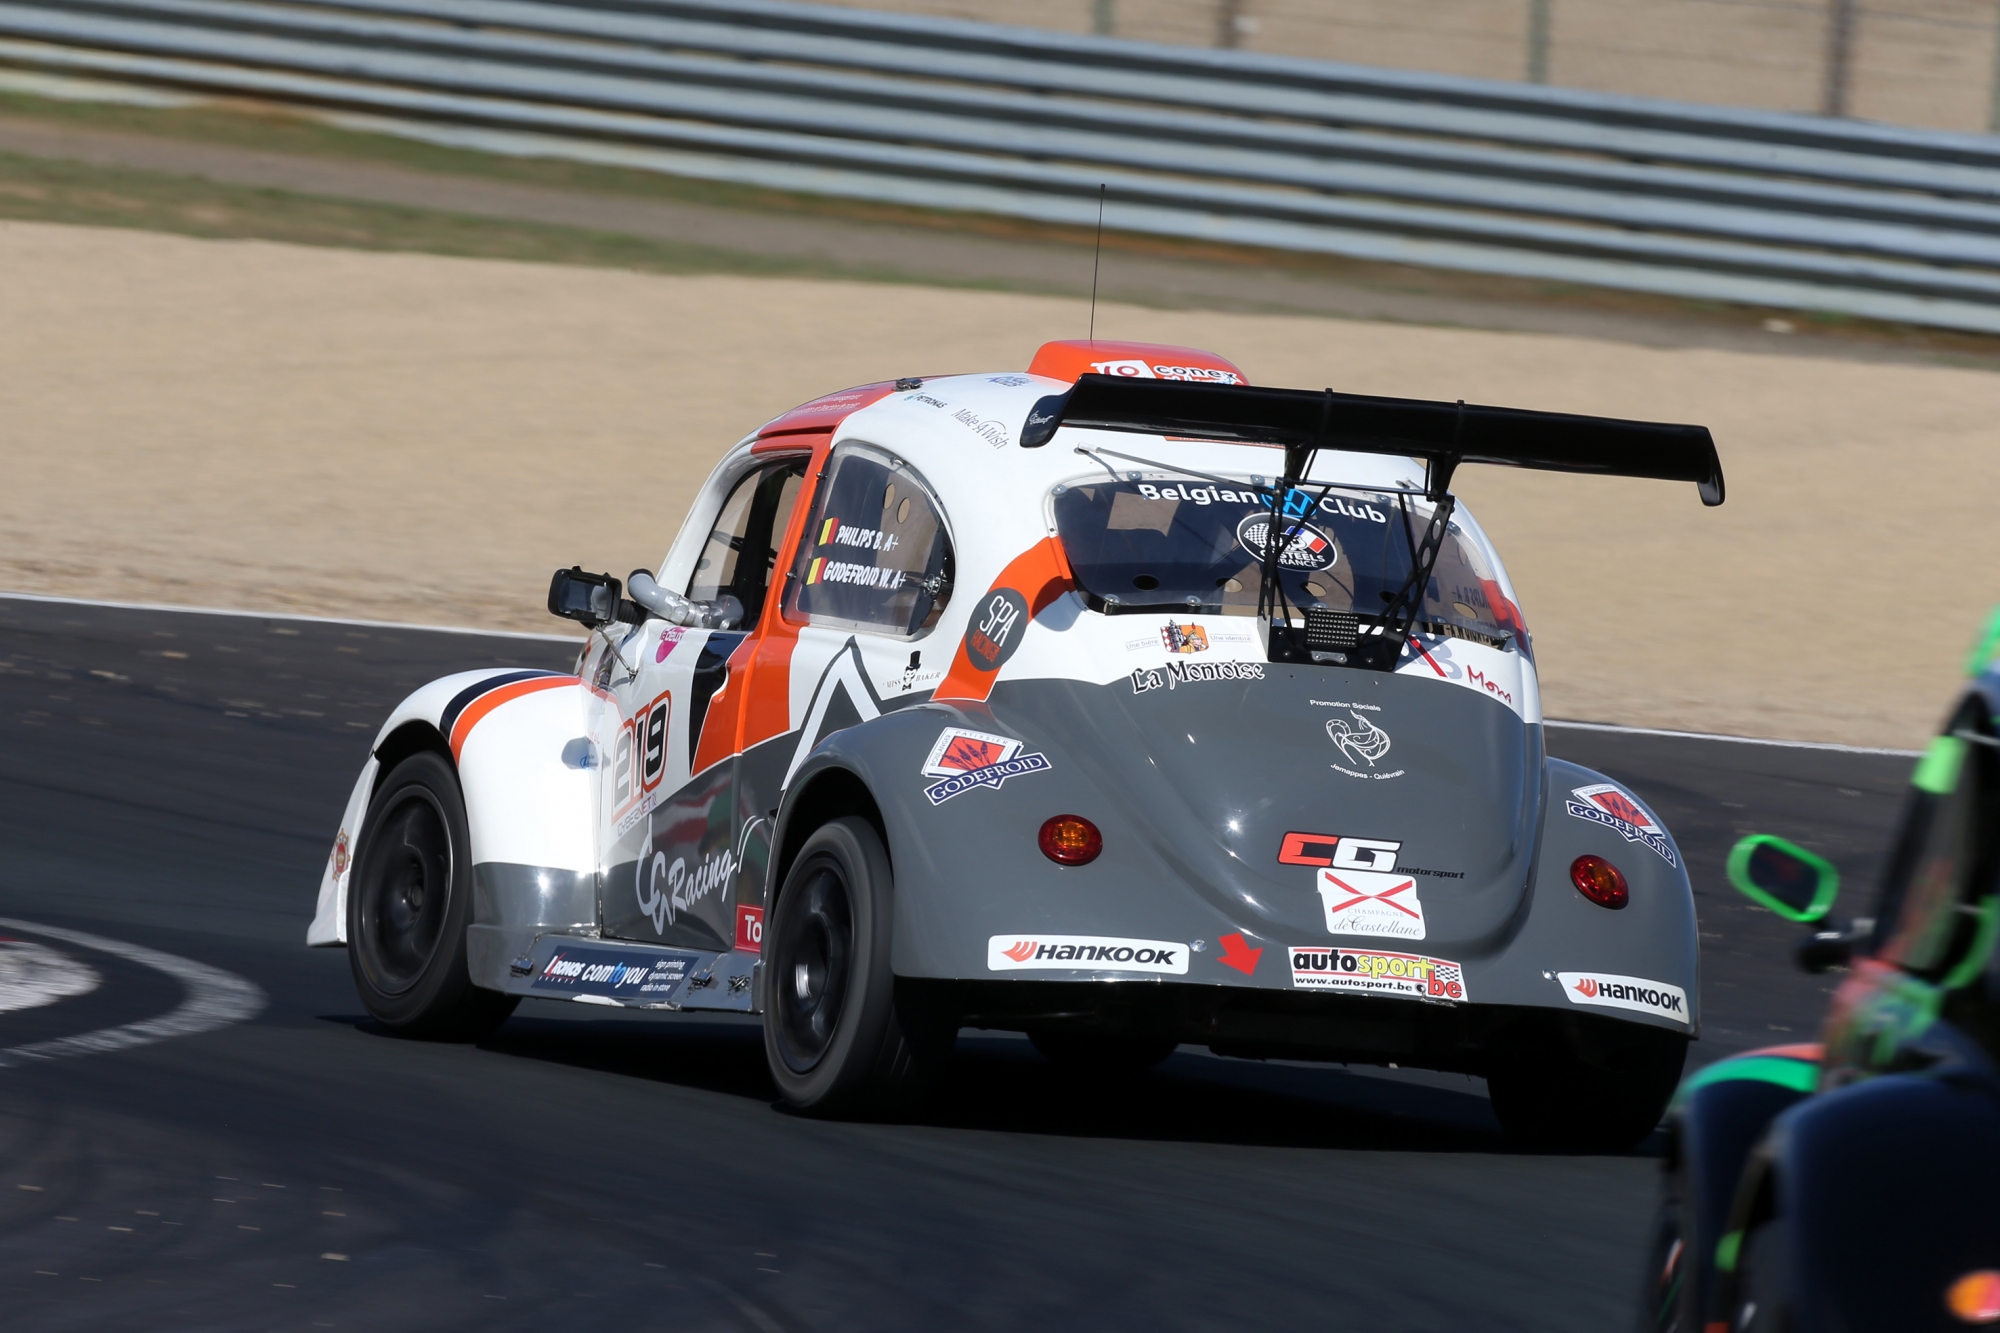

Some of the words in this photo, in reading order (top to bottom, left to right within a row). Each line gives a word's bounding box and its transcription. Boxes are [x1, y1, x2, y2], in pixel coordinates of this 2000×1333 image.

[1155, 366, 1238, 381] conex
[1138, 483, 1260, 506] Belgian
[1319, 497, 1387, 523] Club
[835, 525, 876, 549] PHILIPS
[873, 531, 884, 550] B.
[823, 560, 880, 586] GODEFROID
[979, 595, 1020, 648] SPA
[1131, 667, 1164, 694] La
[1166, 659, 1266, 690] Montoise
[1309, 699, 1351, 708] Promotion
[1352, 702, 1382, 712] Sociale
[930, 734, 952, 767] BOULANGER
[955, 730, 1009, 745] PATISSIER
[611, 690, 672, 827] 219
[1330, 763, 1368, 779] Jemappes
[931, 757, 1042, 801] GODEFROID
[1570, 805, 1672, 860] GODEFROID
[1397, 867, 1465, 879] motorsport
[1347, 908, 1405, 917] CHAMPAGNE
[1293, 949, 1435, 980] autosport
[1428, 970, 1462, 999] be
[1295, 977, 1413, 992] www.autosport.be
